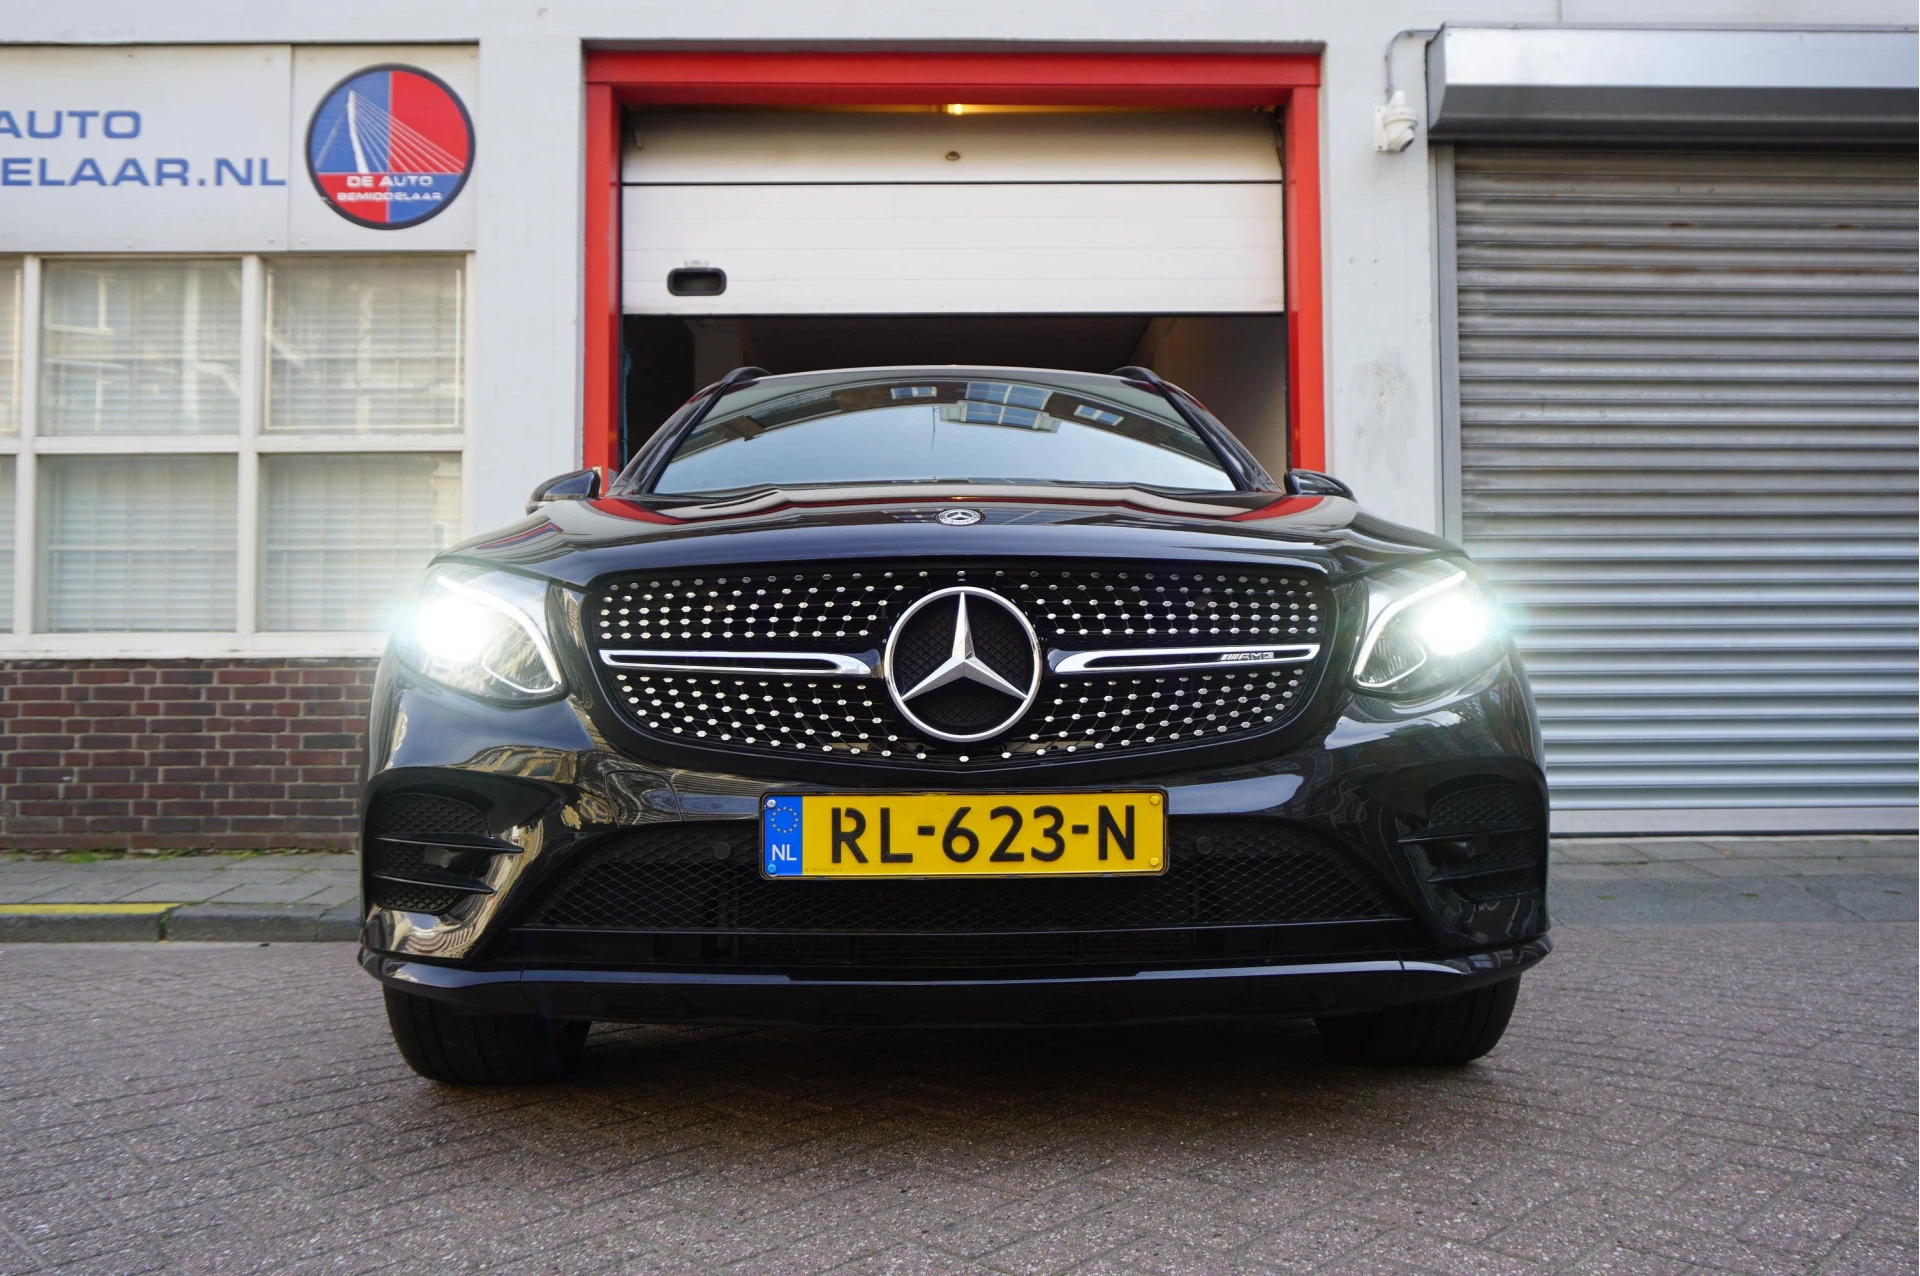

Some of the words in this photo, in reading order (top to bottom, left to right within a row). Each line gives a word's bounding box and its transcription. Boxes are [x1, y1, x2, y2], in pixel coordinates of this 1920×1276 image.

[1, 157, 287, 187] ELAAR.NL
[346, 175, 374, 187] DE
[378, 175, 434, 187] AUTO
[336, 191, 443, 202] BEMIDDELAAR
[1238, 651, 1275, 661] AMG
[771, 843, 798, 861] NL
[831, 804, 1136, 864] RL-623-N
